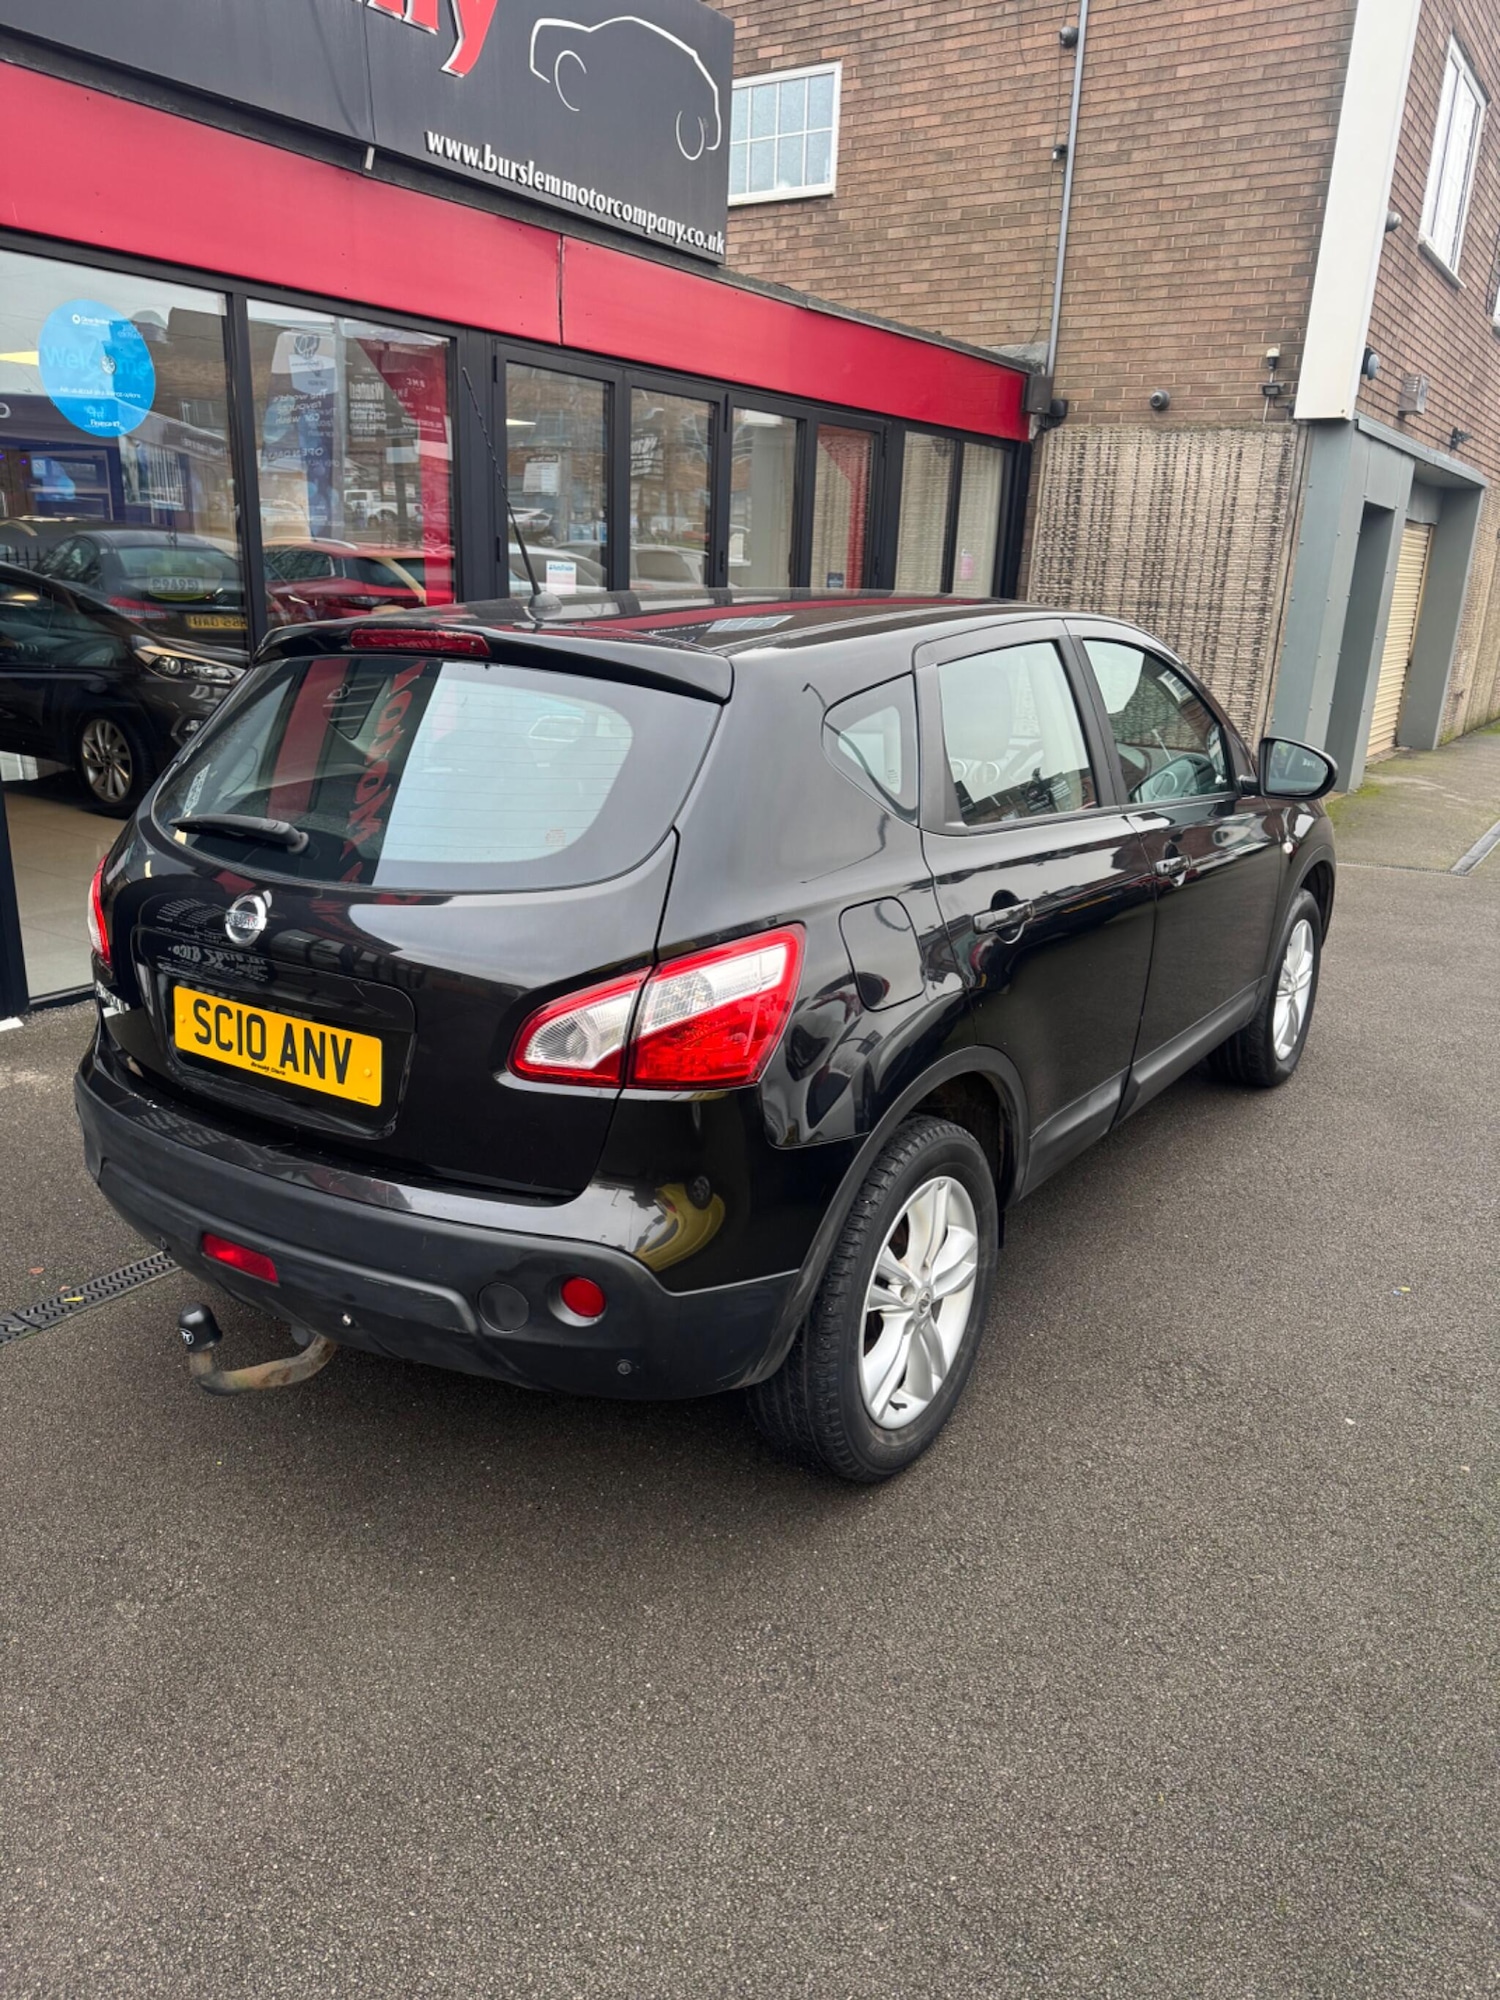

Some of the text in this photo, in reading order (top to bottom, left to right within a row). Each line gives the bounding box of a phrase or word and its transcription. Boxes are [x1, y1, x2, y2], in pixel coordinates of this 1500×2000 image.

[426, 130, 724, 255] www.burslemmotorcompany.co.uk
[193, 998, 353, 1086] SC10 ANV
